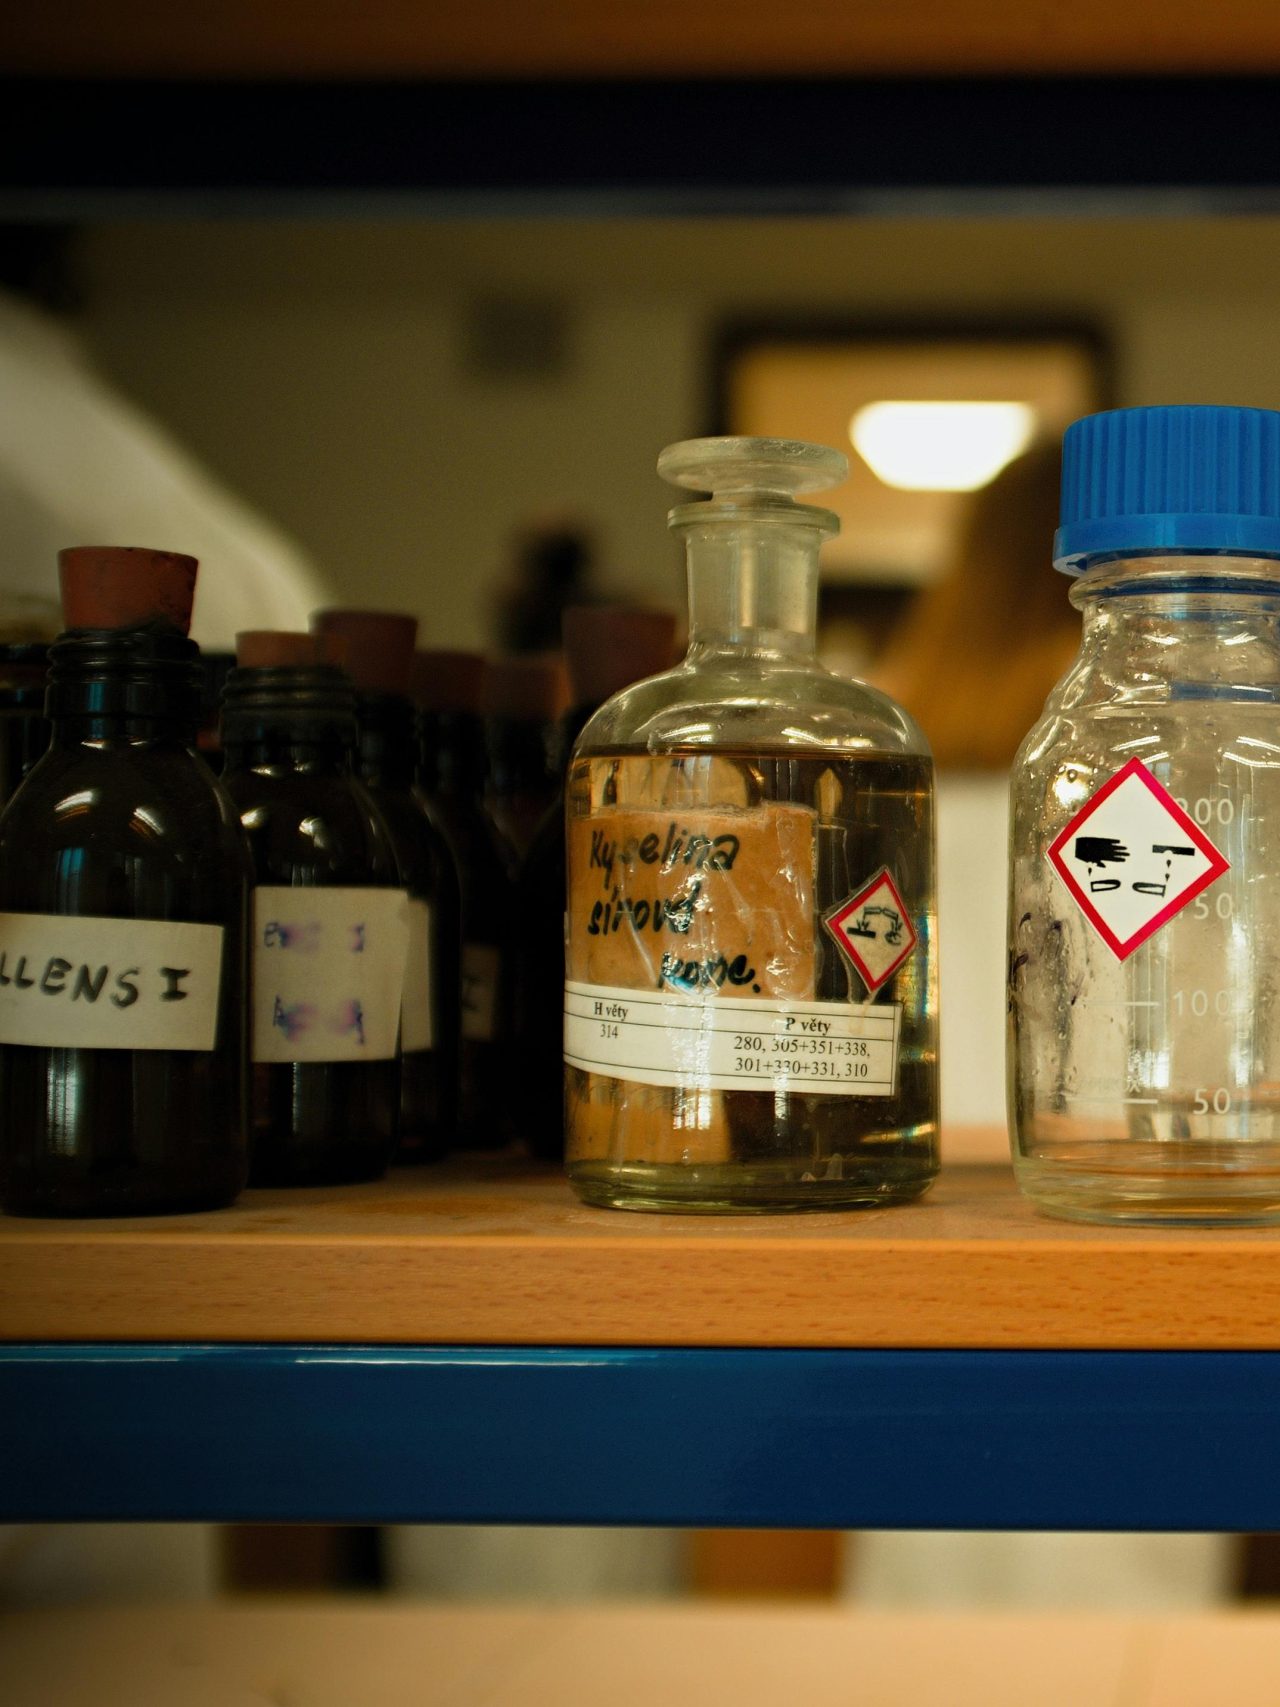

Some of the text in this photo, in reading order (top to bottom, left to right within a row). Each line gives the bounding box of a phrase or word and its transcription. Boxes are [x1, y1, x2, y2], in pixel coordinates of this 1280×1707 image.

[159, 966, 191, 1001] I
[594, 1002, 629, 1021] H věty
[1173, 990, 1232, 1017] 100
[600, 1024, 619, 1039] 314
[785, 1017, 832, 1036] P věty
[733, 1035, 767, 1052] 280,
[735, 1057, 868, 1078] 301+330+331, 310
[1193, 1088, 1231, 1115] 50
